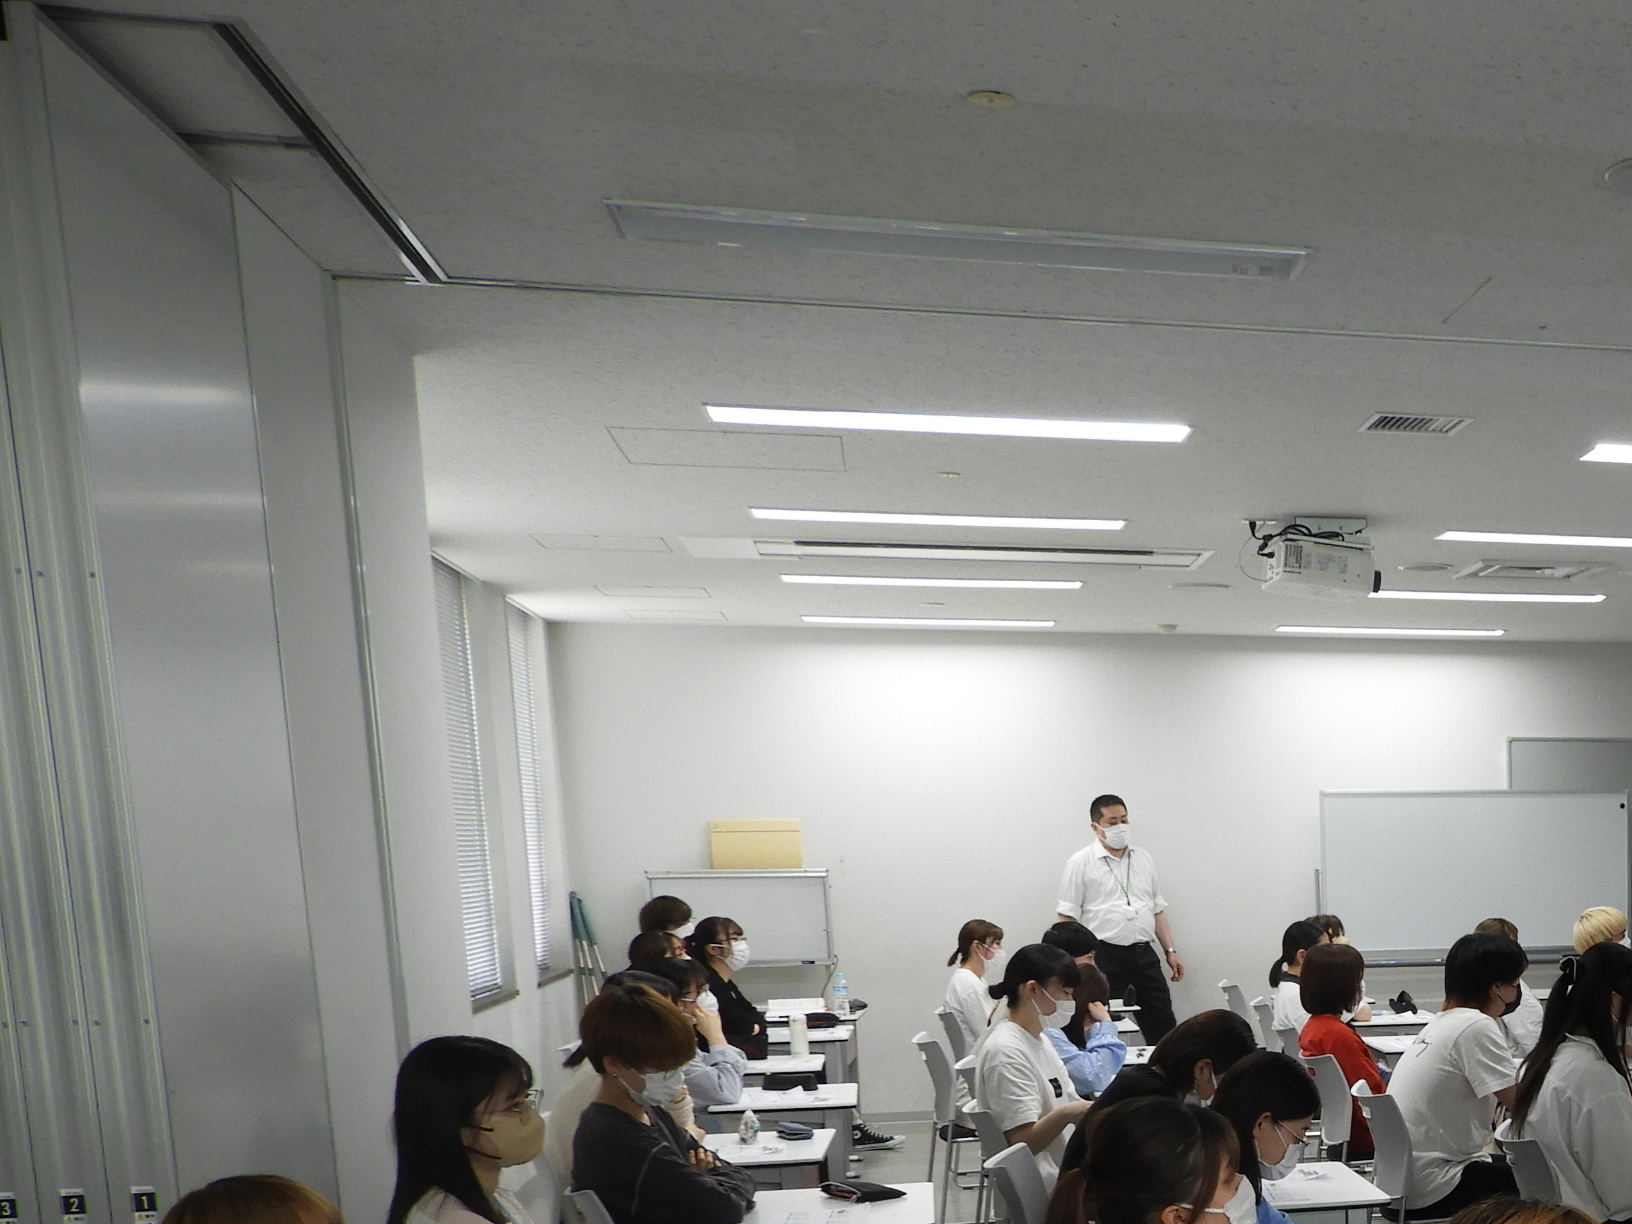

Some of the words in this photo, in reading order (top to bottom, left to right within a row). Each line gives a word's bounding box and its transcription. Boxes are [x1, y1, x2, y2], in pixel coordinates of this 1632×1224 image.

[2, 1201, 11, 1216] 3
[69, 1197, 80, 1212] 2
[140, 1195, 149, 1210] 1
